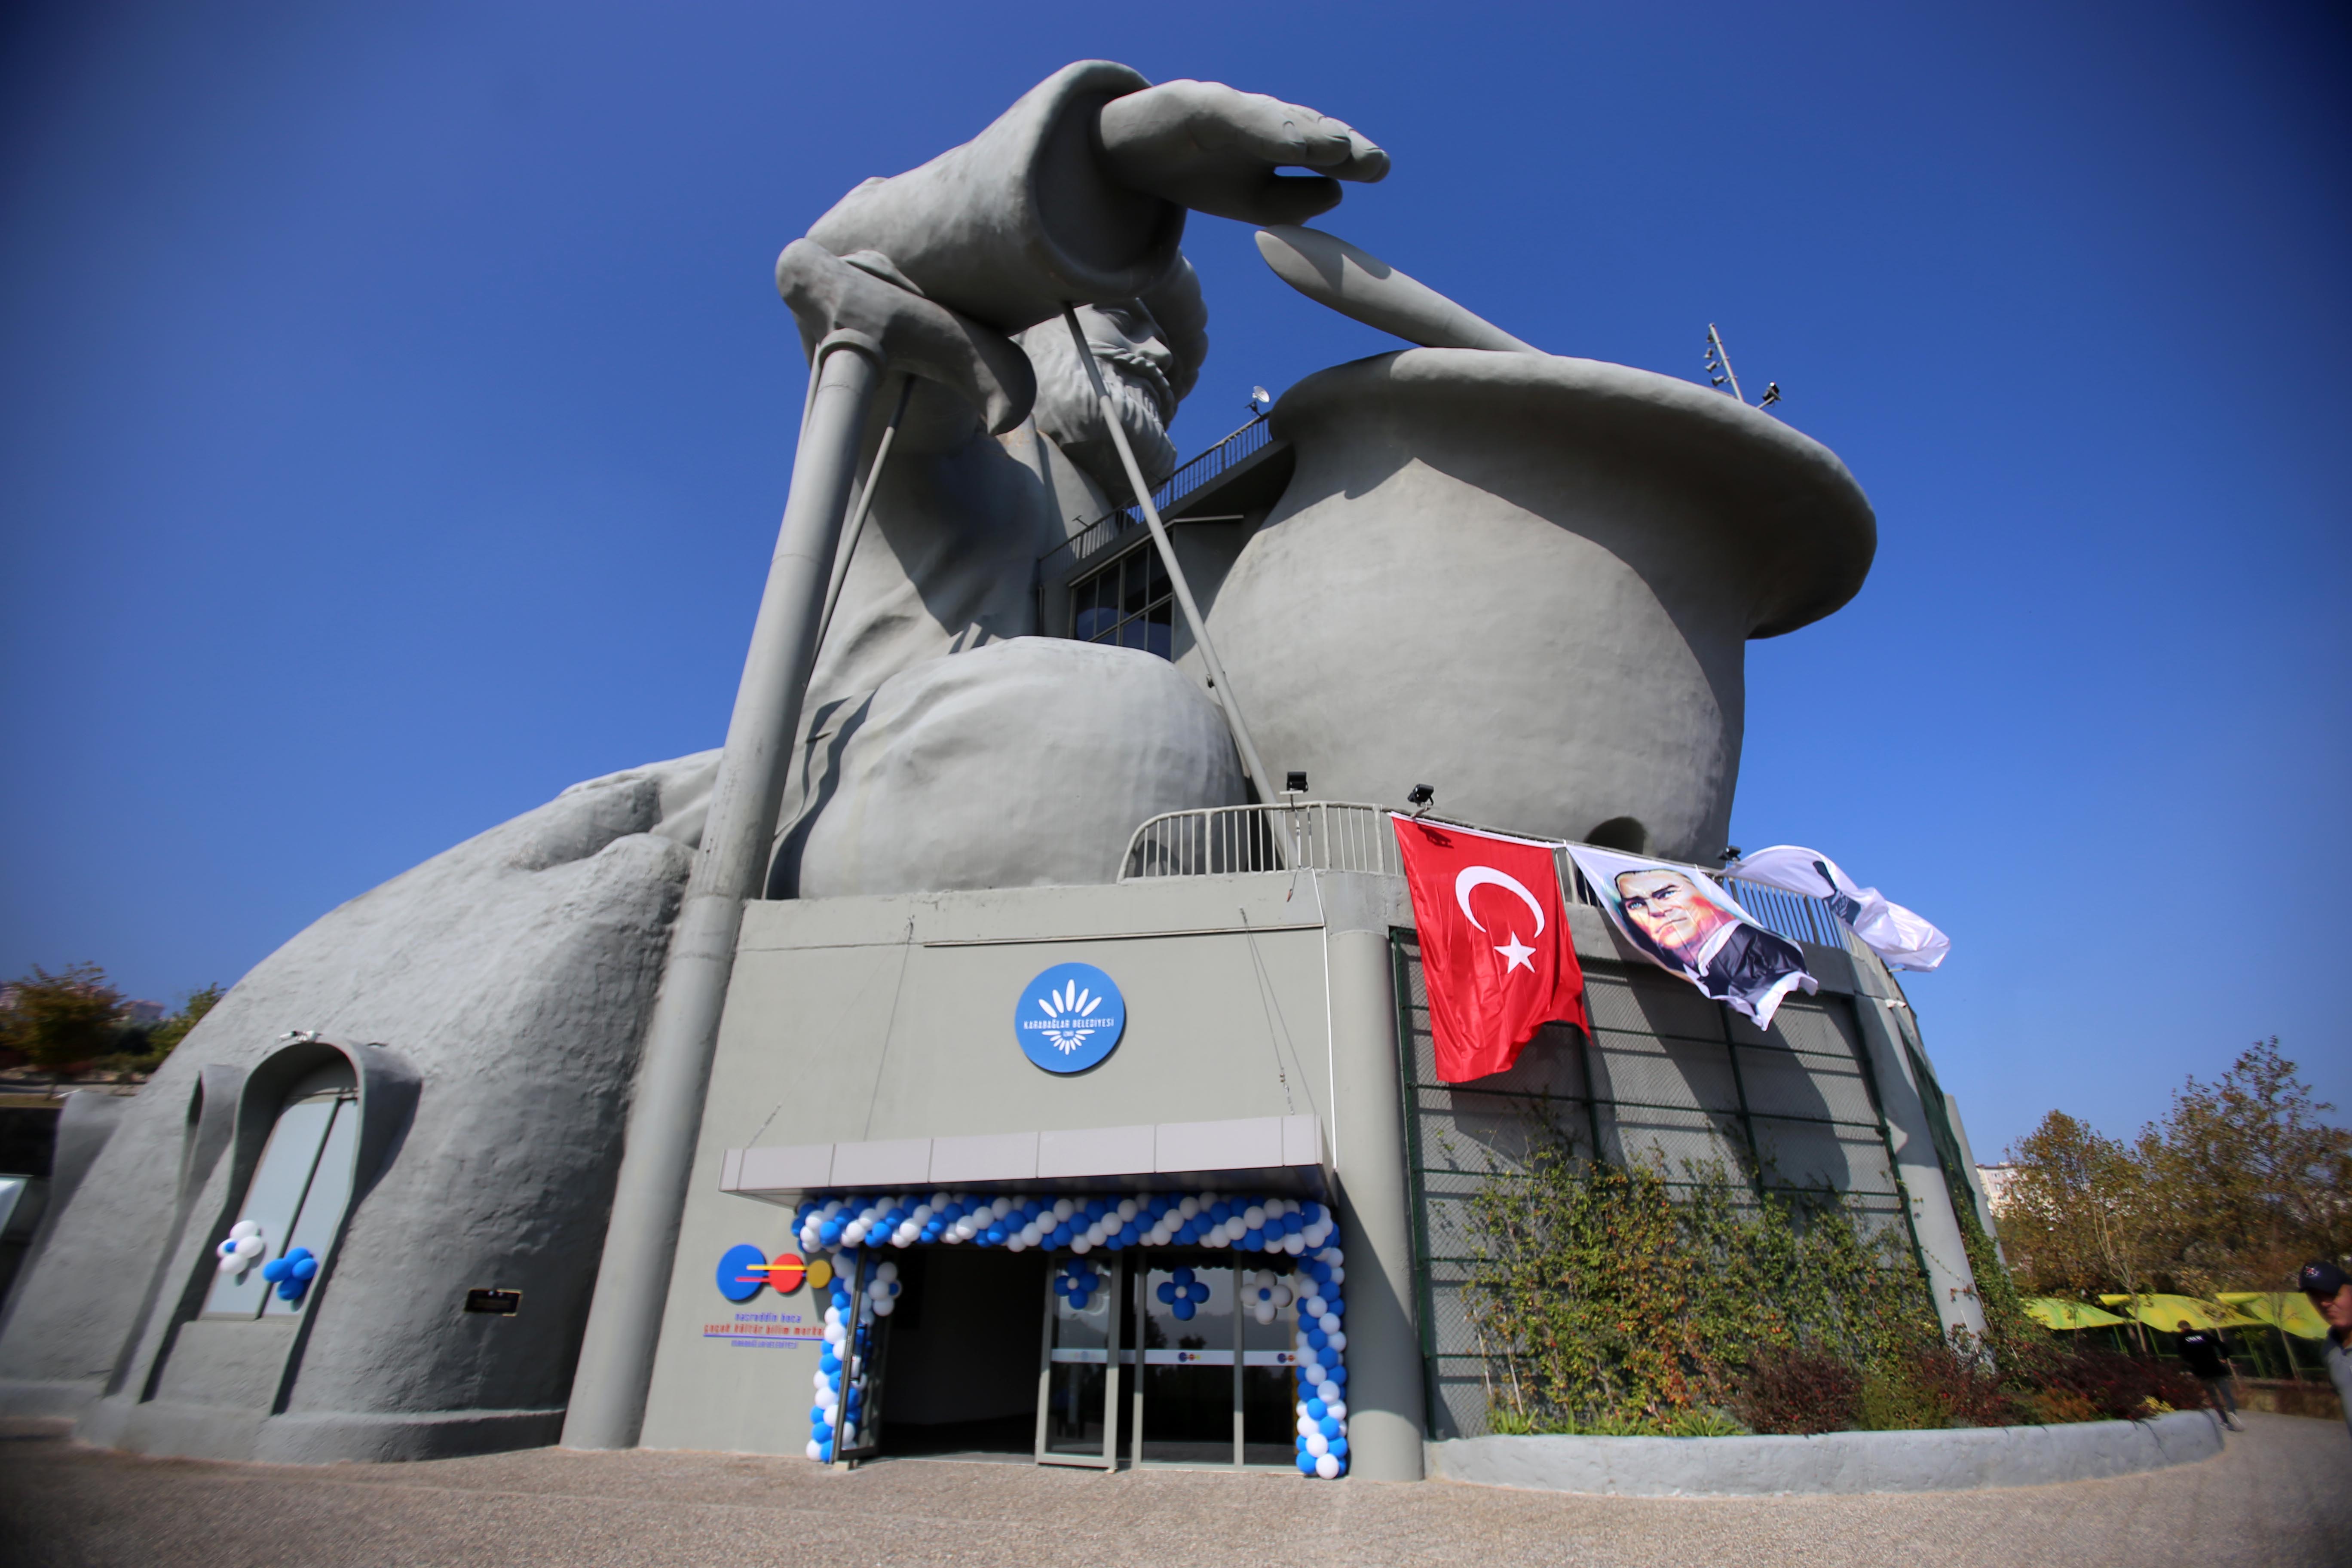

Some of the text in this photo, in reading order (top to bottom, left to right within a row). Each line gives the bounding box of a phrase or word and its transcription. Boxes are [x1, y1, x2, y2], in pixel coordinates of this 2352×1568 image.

[1023, 1017, 1114, 1029] KARABAĞLAR BELEDİYESİ
[781, 1314, 802, 1323] hoca
